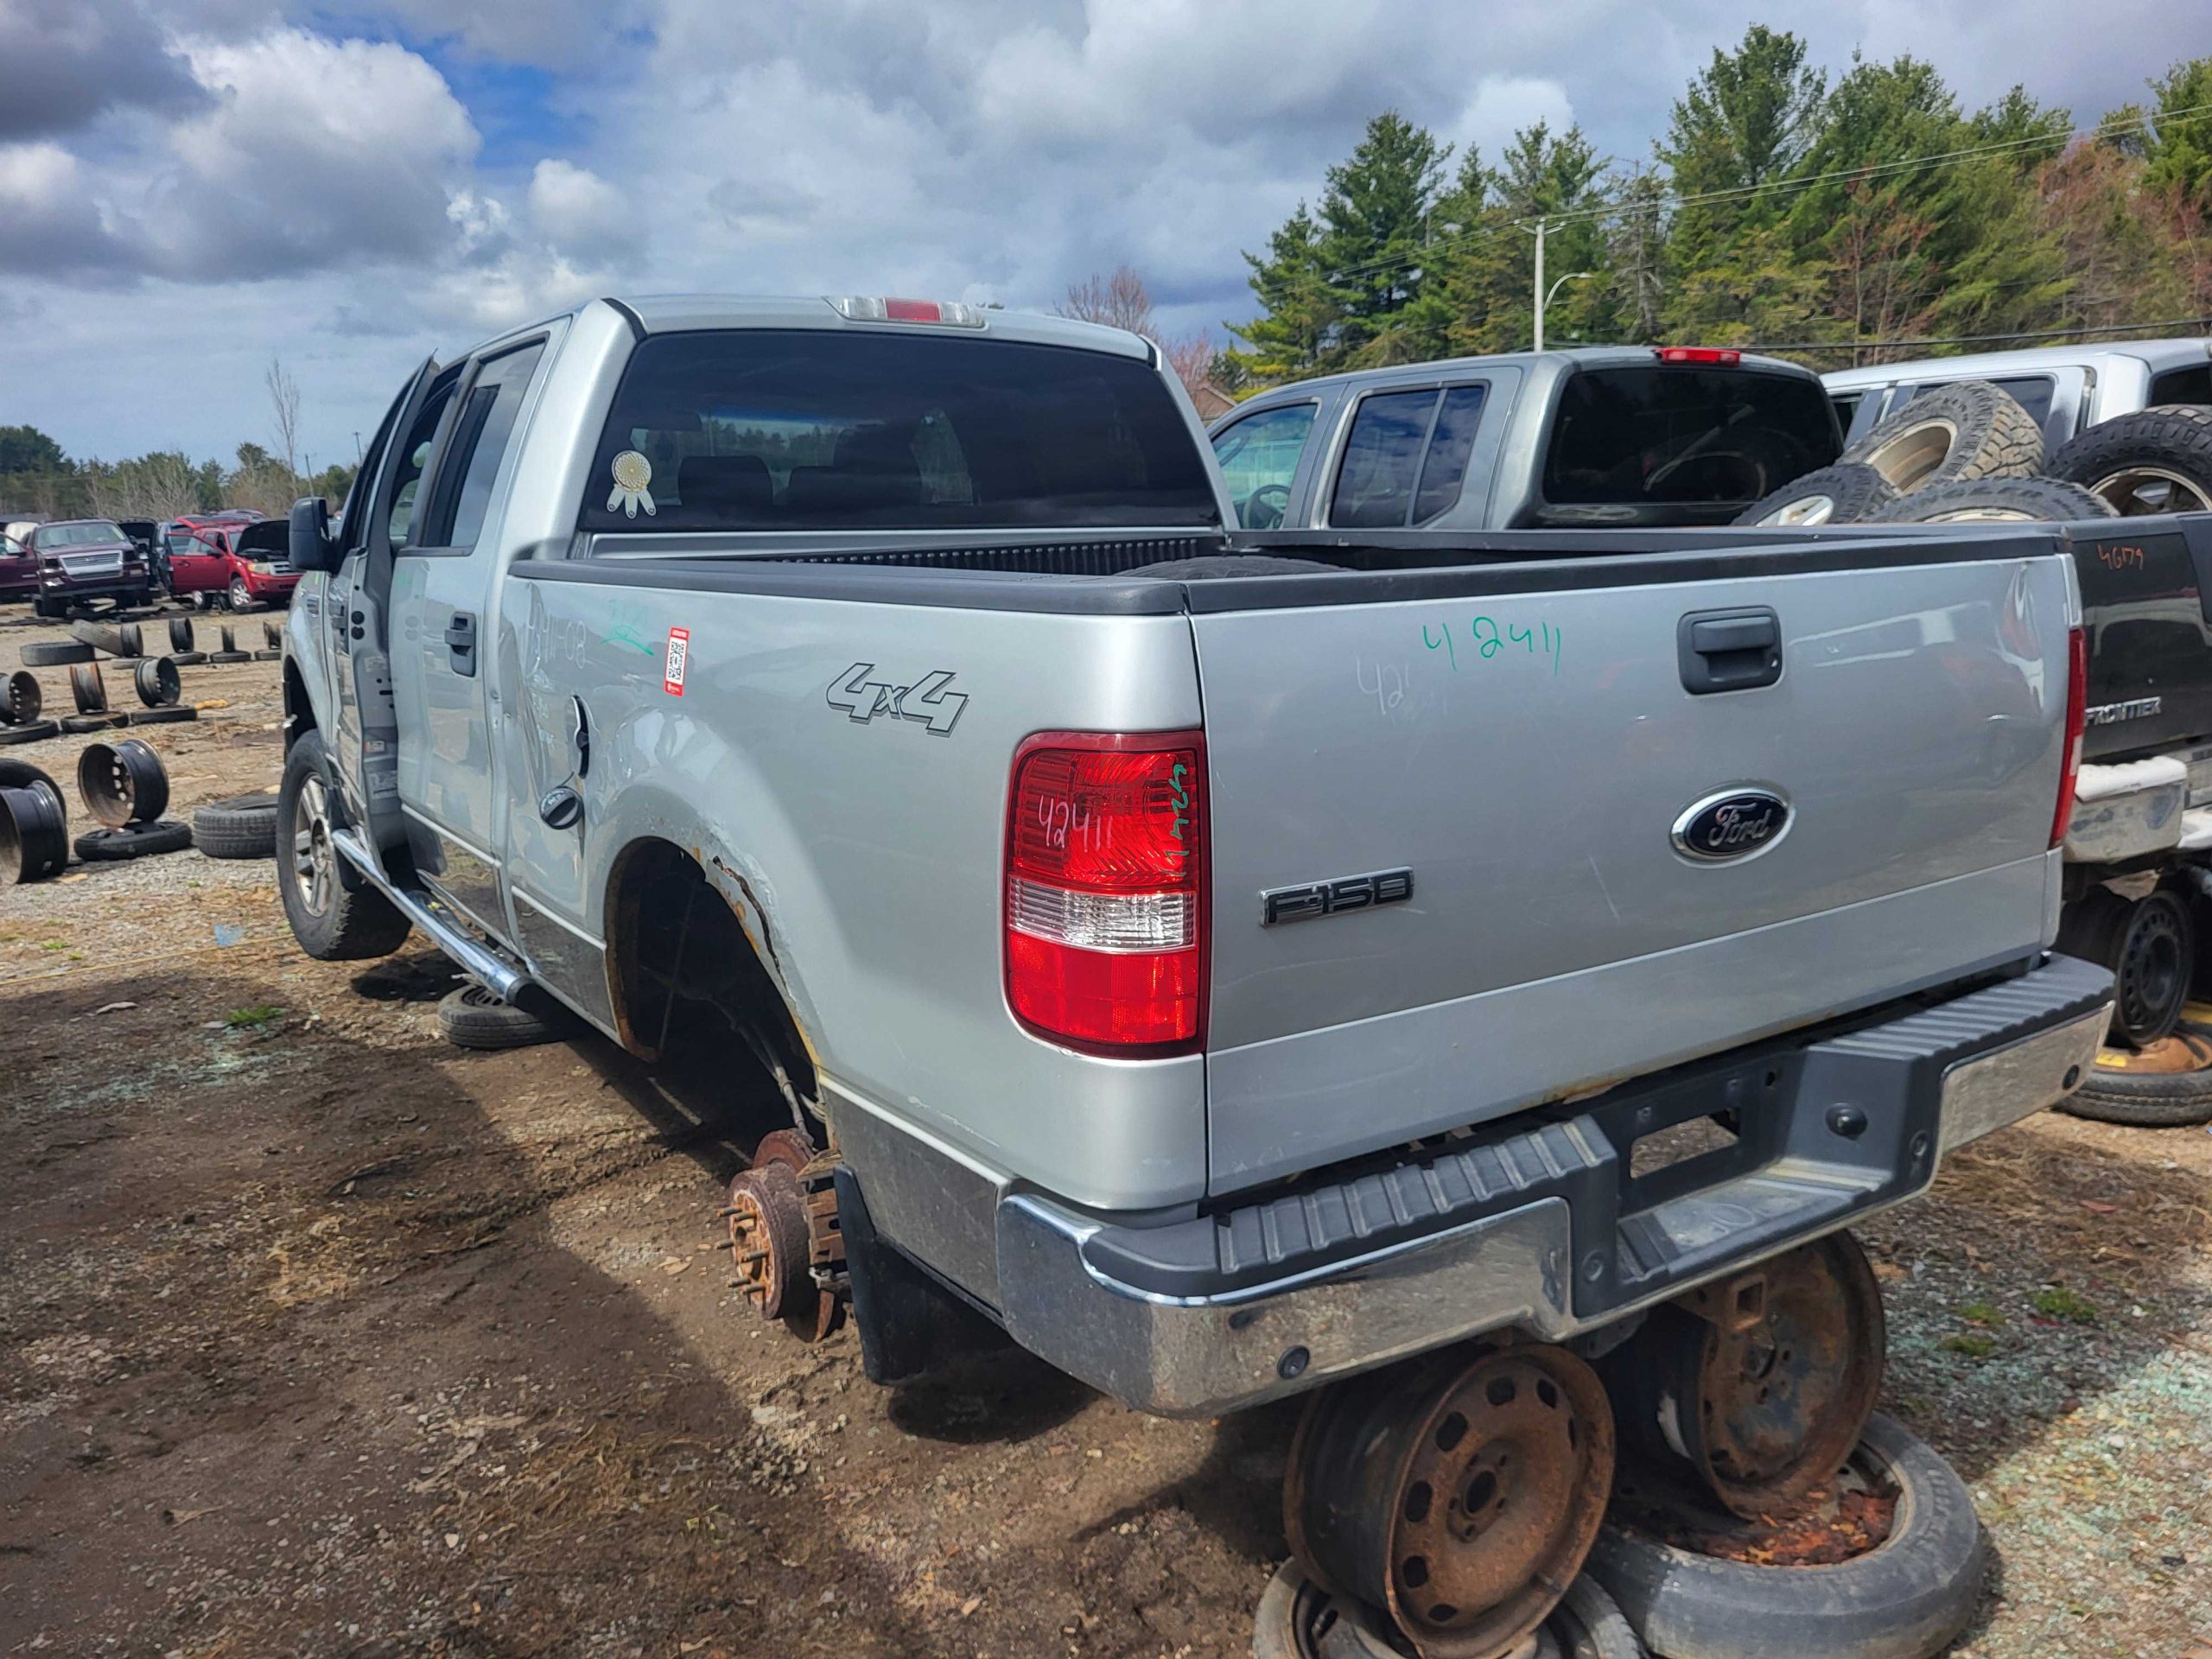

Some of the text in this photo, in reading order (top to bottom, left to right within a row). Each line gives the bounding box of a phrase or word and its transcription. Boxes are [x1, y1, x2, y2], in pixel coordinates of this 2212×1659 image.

[826, 662, 970, 738] 4x4
[1707, 802, 1773, 847] Ford
[1260, 867, 1415, 927] F-150
